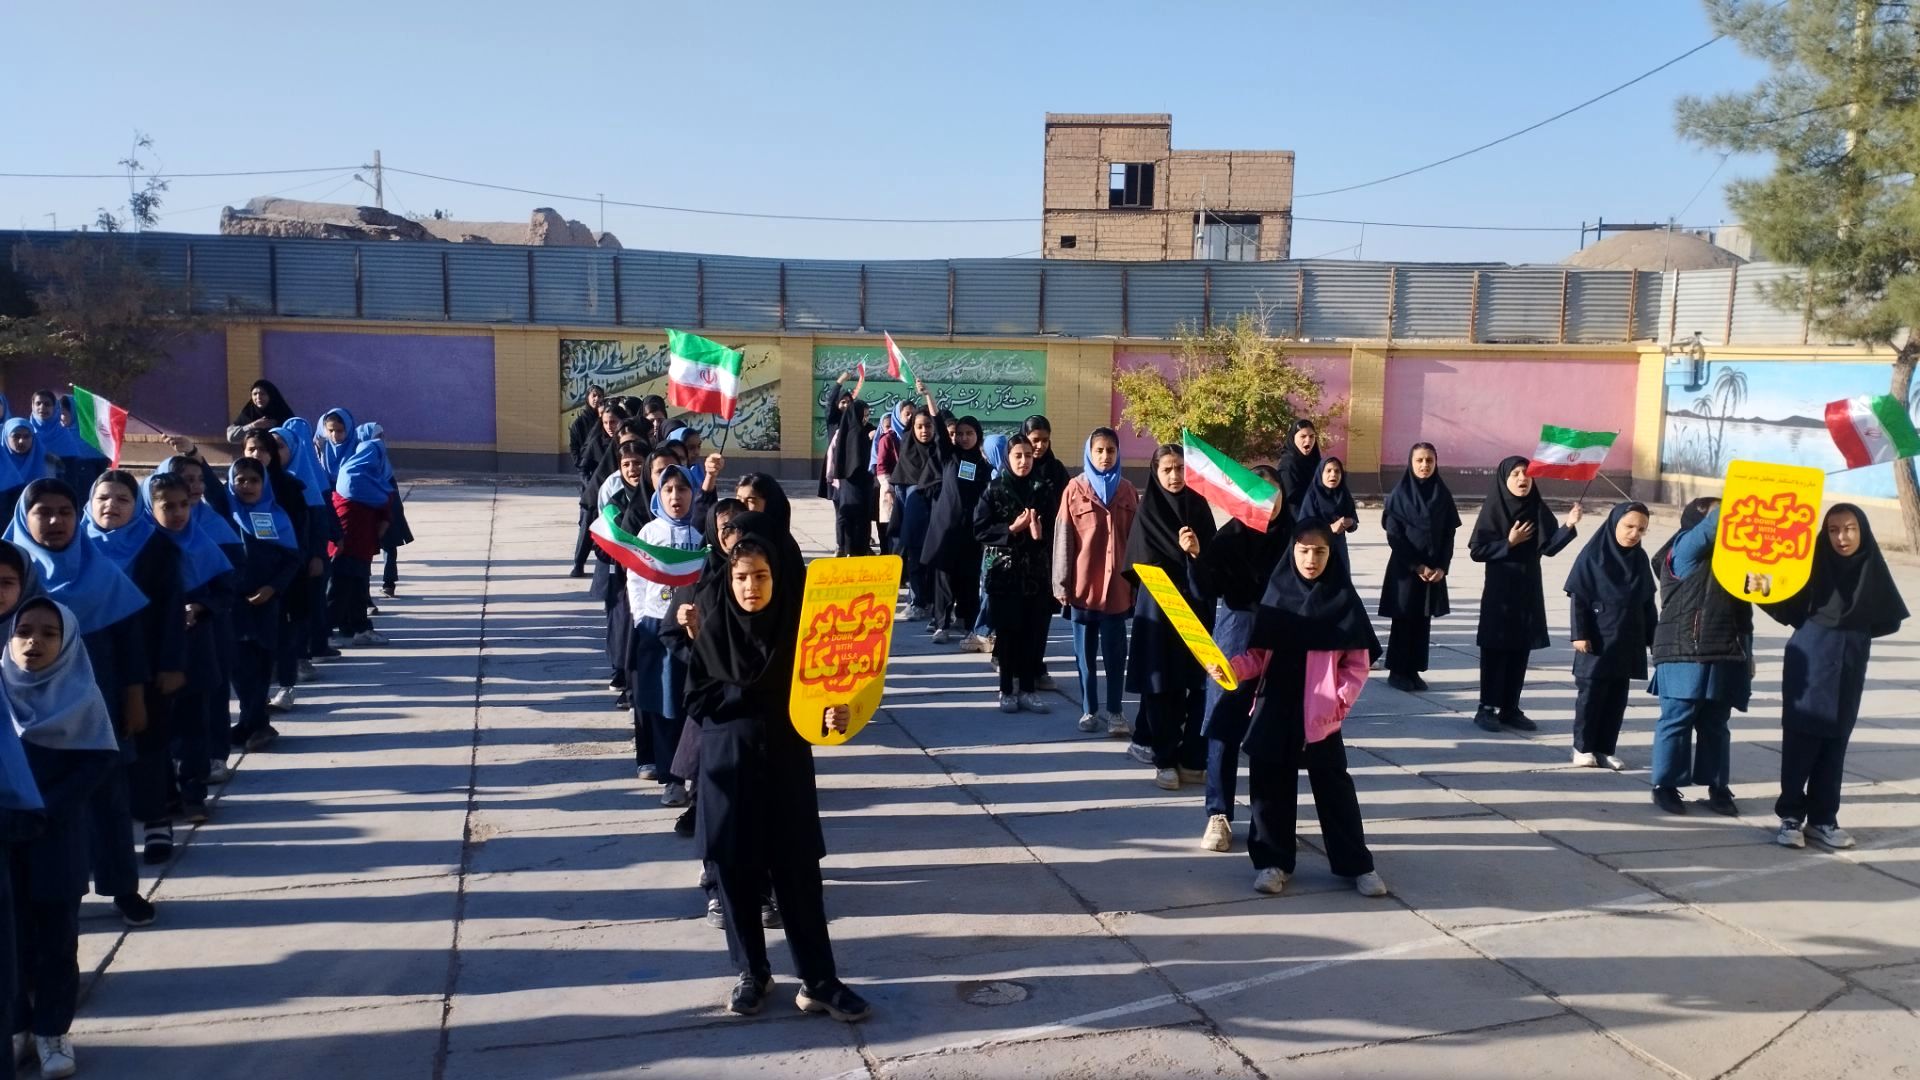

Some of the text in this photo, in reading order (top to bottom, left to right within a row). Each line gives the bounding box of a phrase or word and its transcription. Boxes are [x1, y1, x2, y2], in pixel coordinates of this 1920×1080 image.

[1728, 496, 1811, 529] مرگ بر
[1758, 526, 1776, 534] WITH
[805, 599, 887, 647] مرگ بر
[831, 632, 855, 642] DOWN
